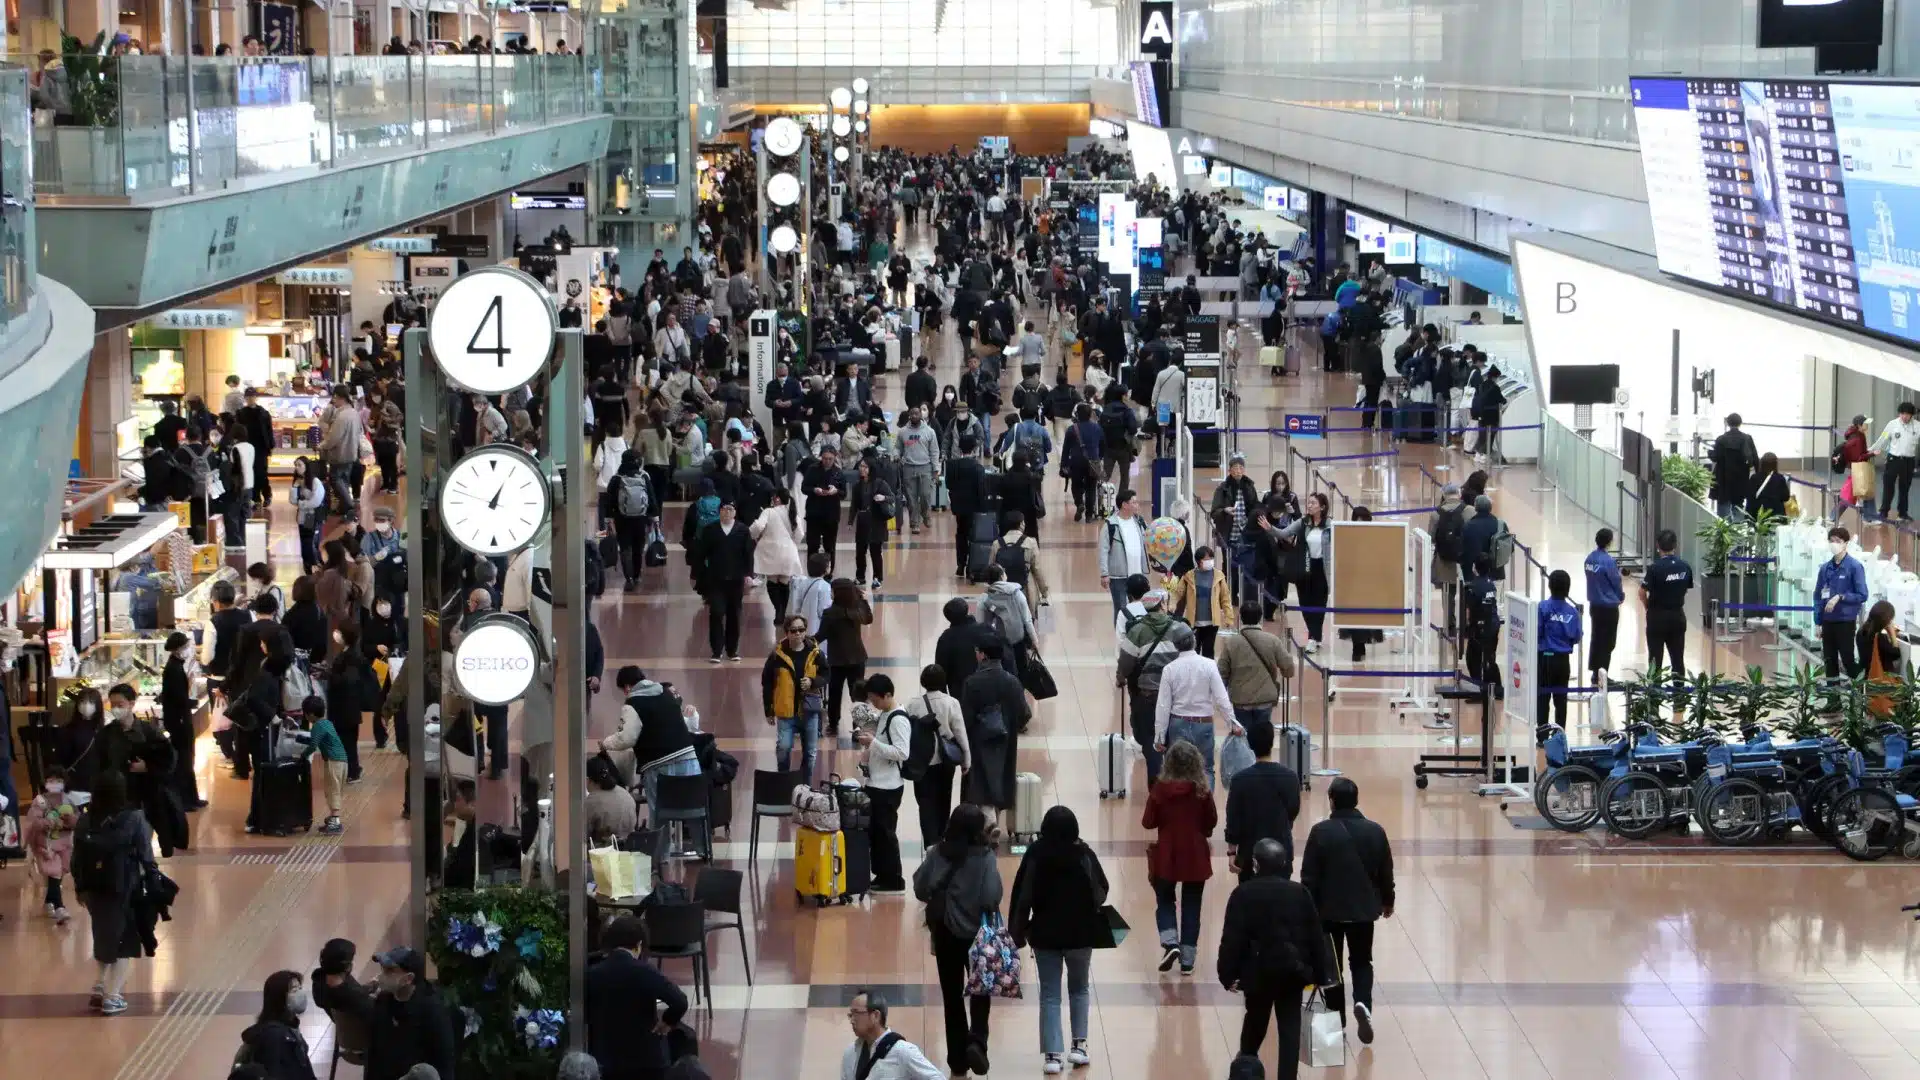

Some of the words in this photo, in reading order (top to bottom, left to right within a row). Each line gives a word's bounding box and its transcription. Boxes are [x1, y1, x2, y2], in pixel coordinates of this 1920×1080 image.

[1142, 11, 1172, 44] A
[776, 124, 790, 148] 3
[1177, 137, 1193, 154] A
[1556, 282, 1577, 314] B
[466, 295, 511, 367] 4
[757, 341, 765, 394] Information
[1666, 572, 1680, 581] ANA
[462, 657, 529, 671] SEIKO
